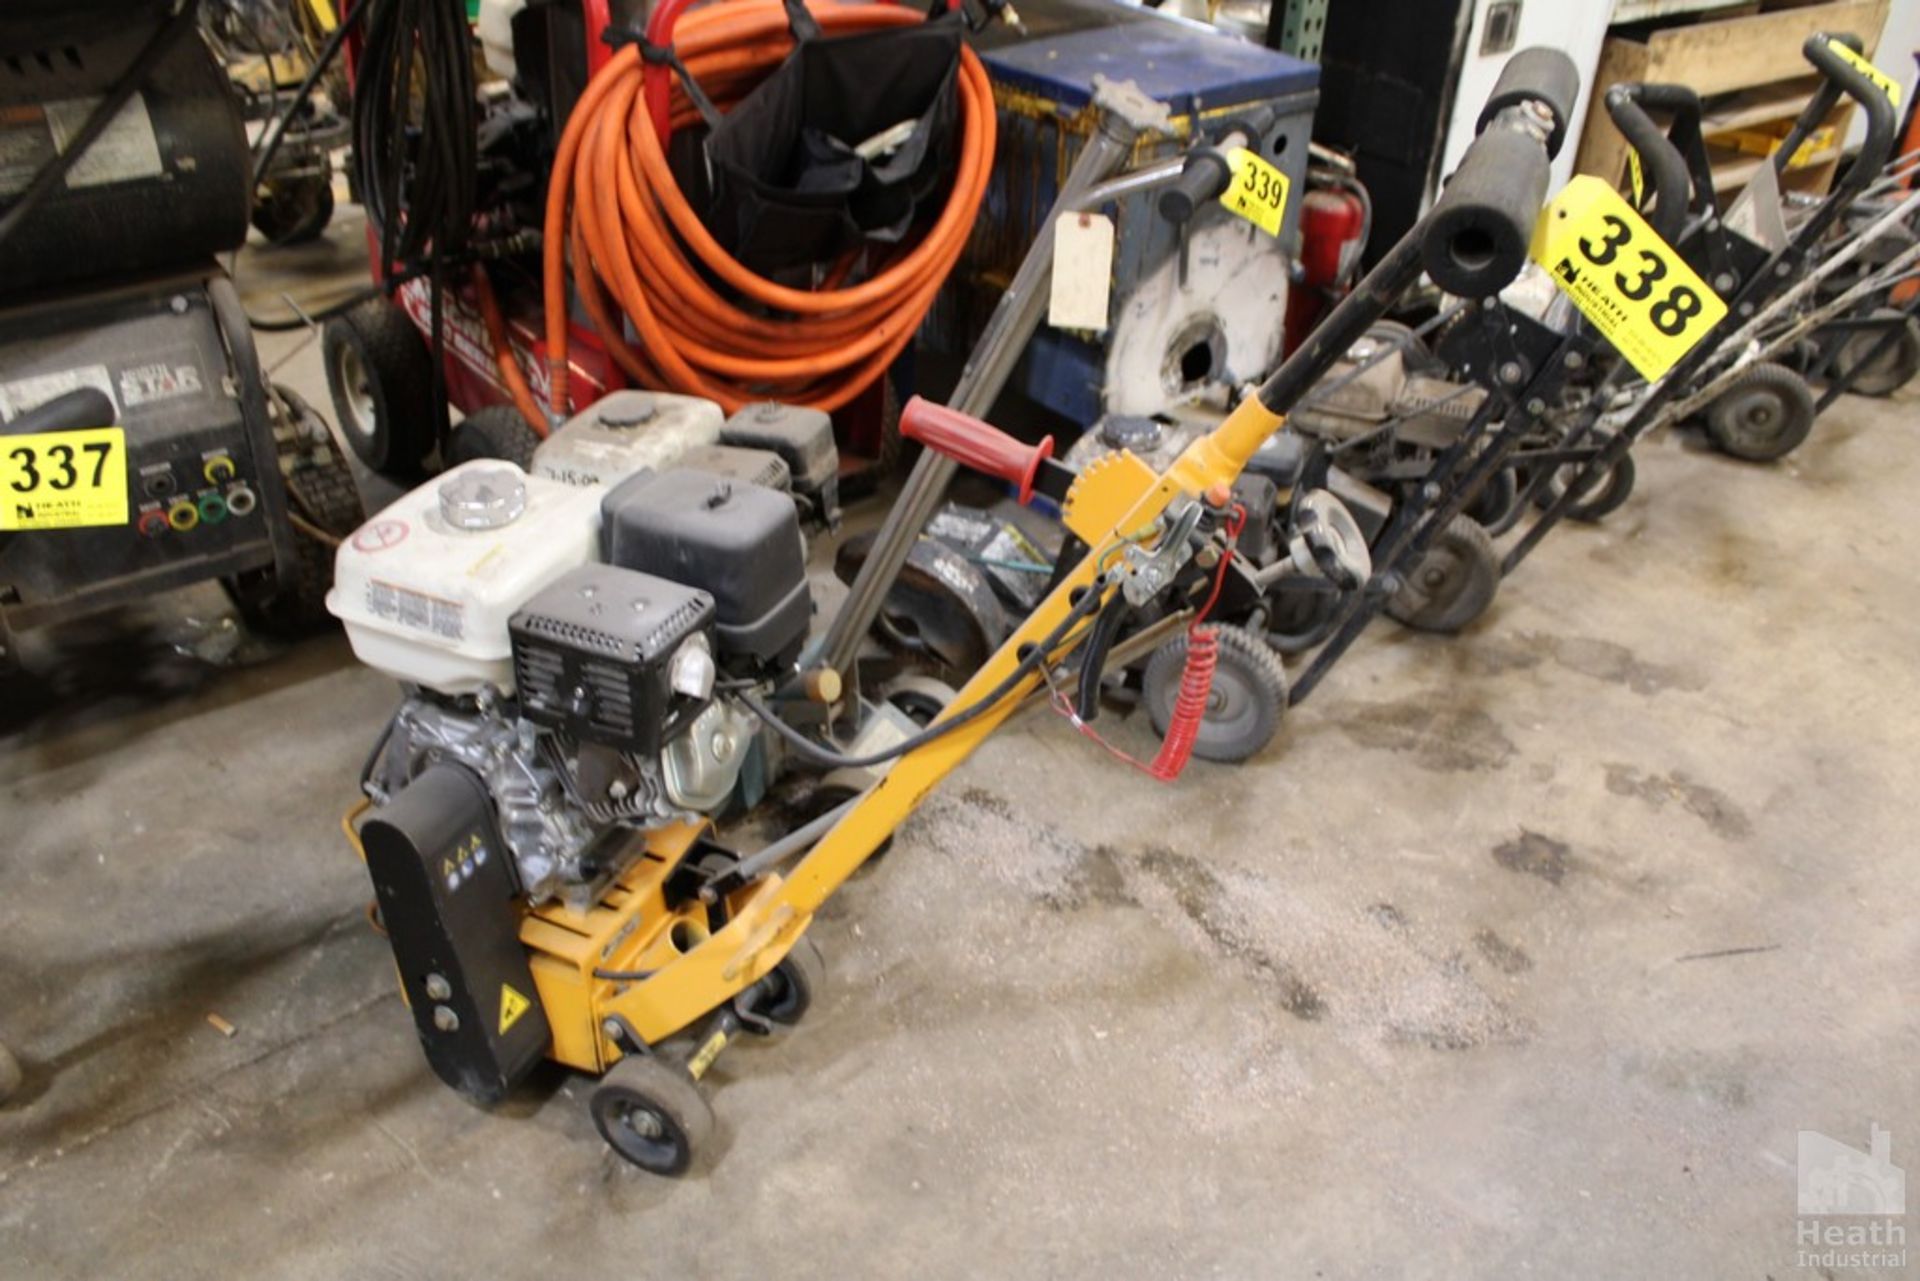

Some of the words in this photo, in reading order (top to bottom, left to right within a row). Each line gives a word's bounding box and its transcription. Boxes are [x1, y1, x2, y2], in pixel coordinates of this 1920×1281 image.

[1244, 161, 1282, 209] 339
[1578, 214, 1703, 337] 338
[1581, 276, 1628, 322] HEATH
[9, 441, 112, 493] 337
